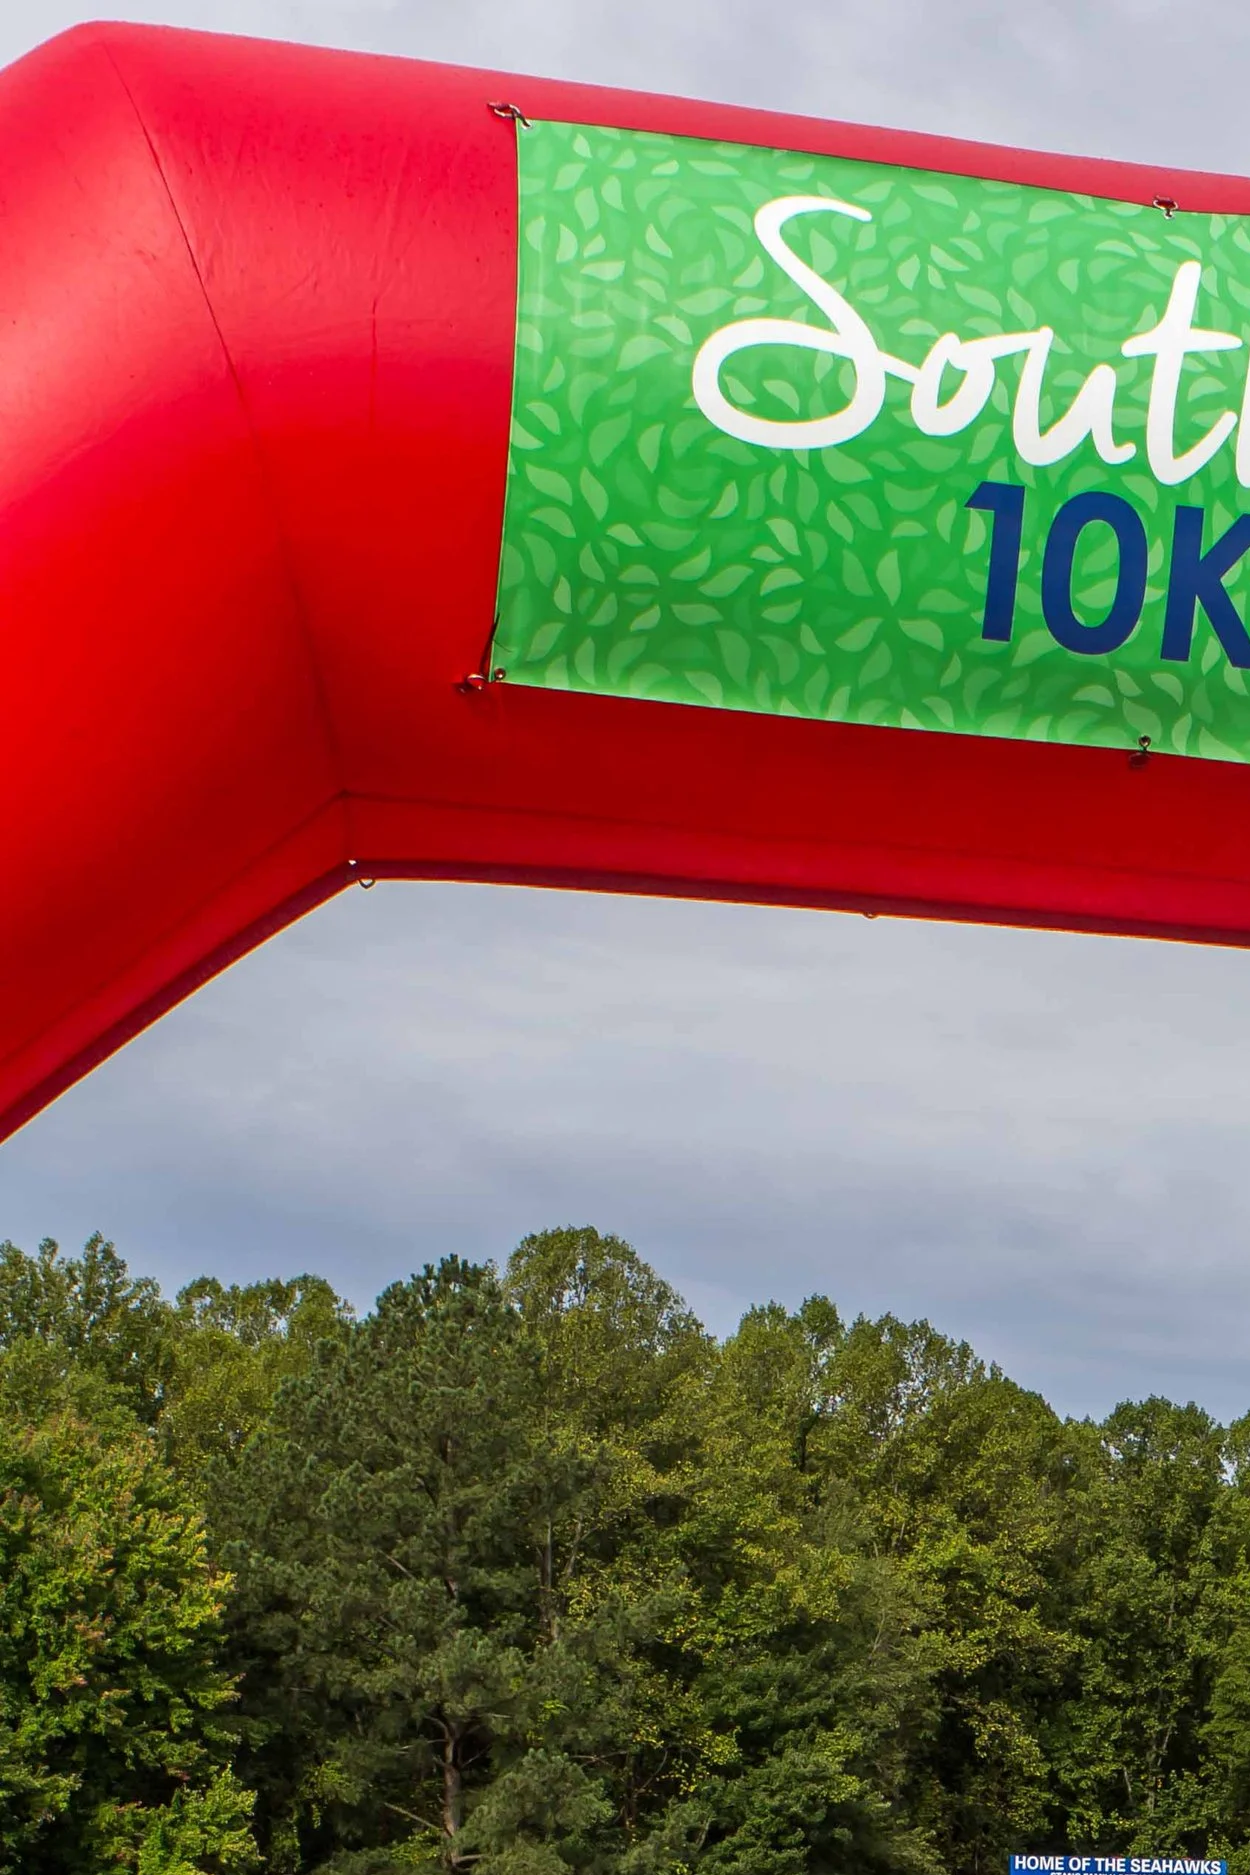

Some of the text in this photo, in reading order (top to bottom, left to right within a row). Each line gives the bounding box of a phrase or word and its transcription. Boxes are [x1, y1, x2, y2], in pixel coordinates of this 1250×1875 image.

[1014, 1855, 1222, 1875] HOME OF THE SEAHAWKS
